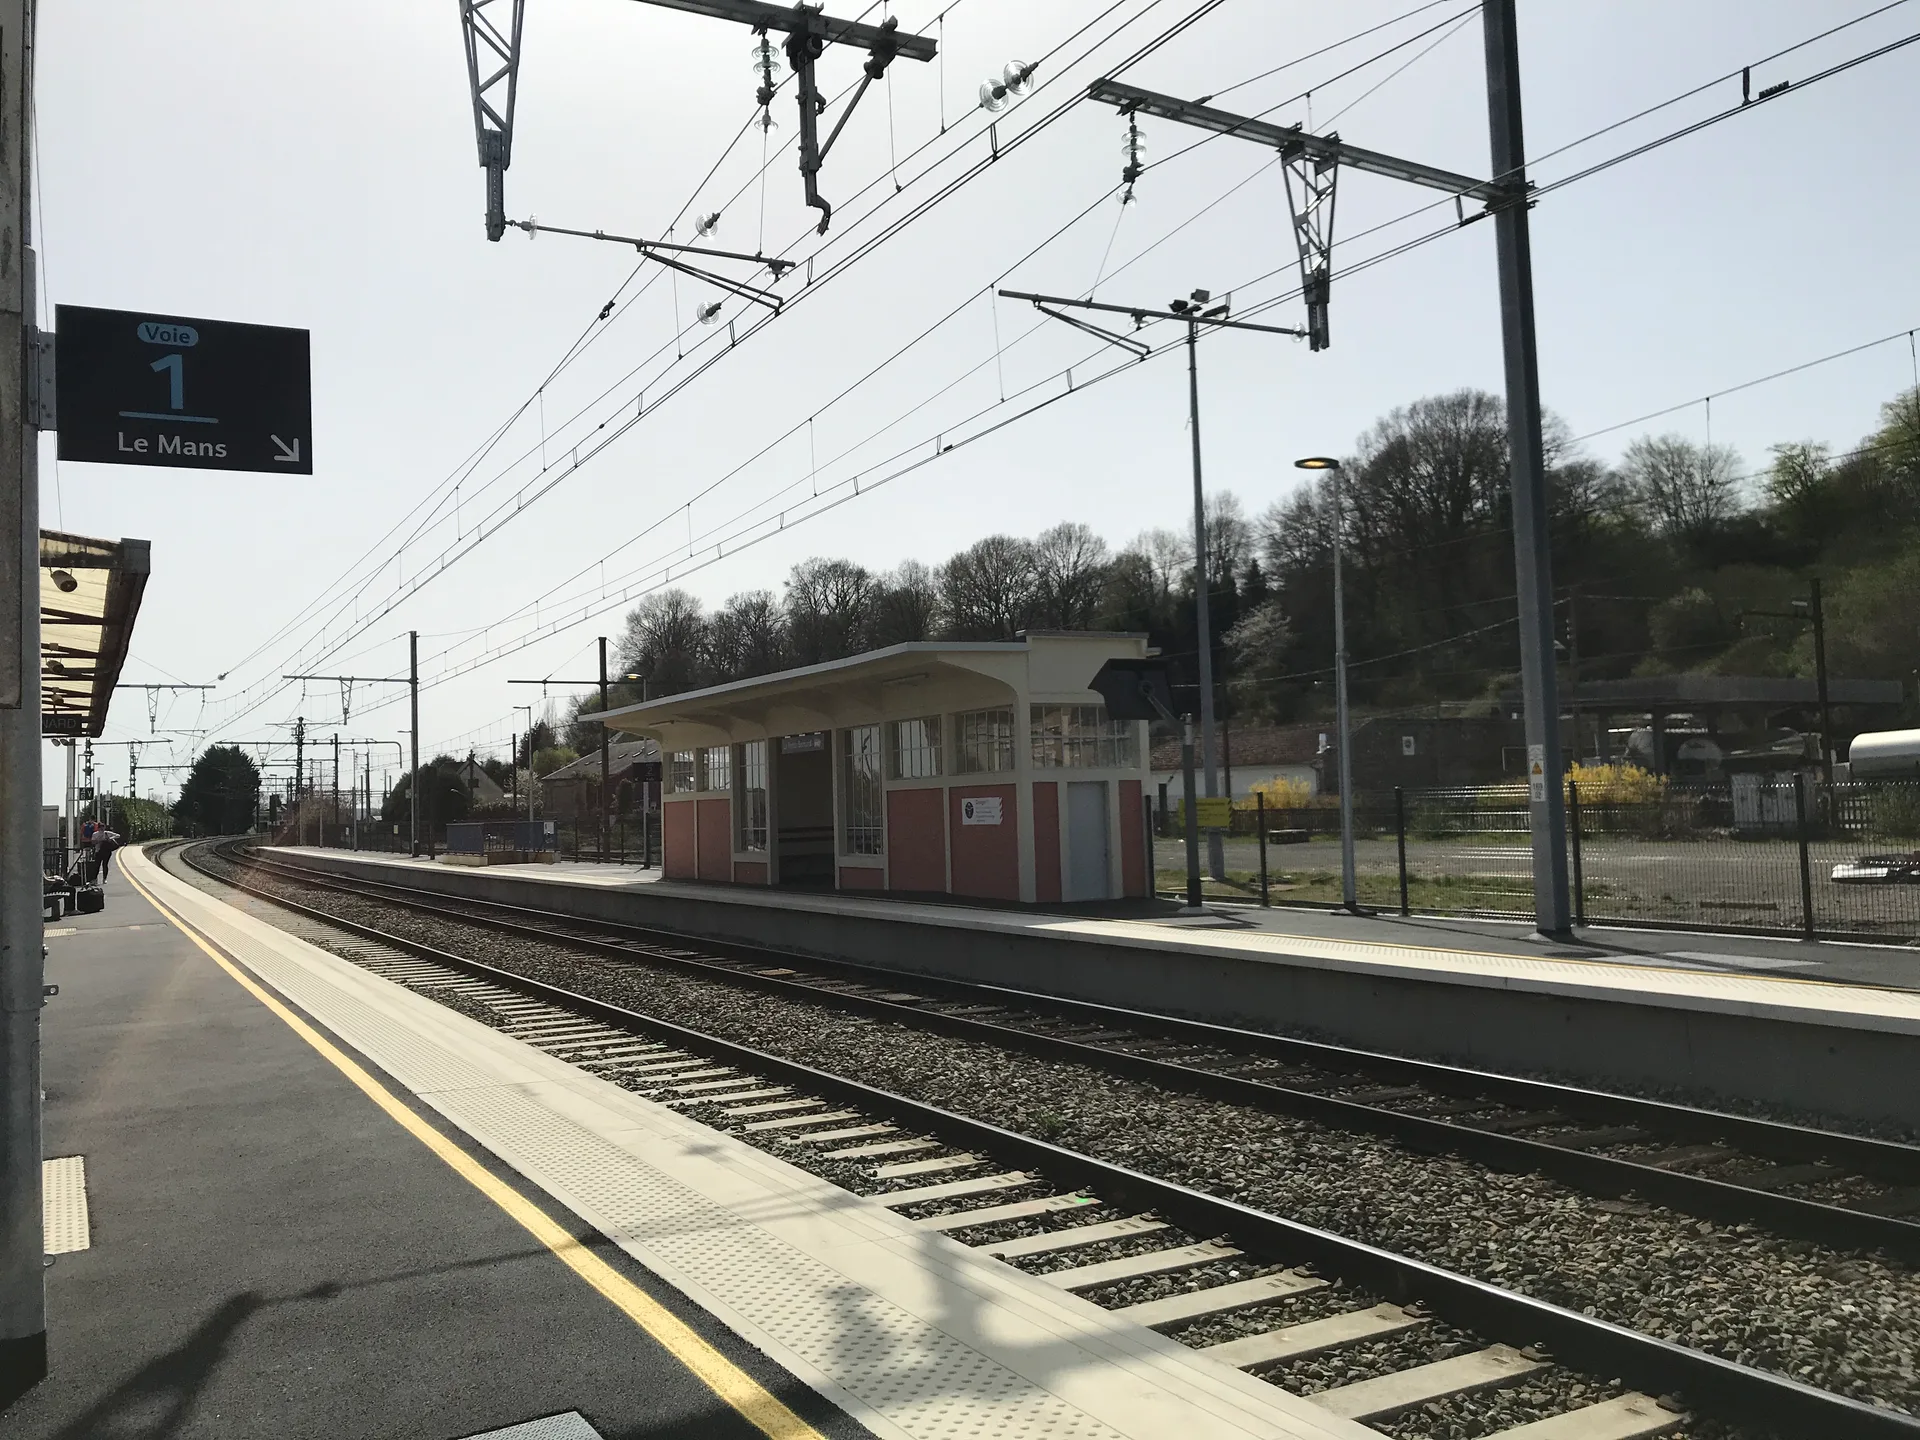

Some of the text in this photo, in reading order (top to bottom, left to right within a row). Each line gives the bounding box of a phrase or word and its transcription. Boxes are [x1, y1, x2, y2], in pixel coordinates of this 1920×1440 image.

[144, 325, 191, 344] Voie
[150, 353, 184, 410] 1
[118, 431, 228, 459] Le Mans
